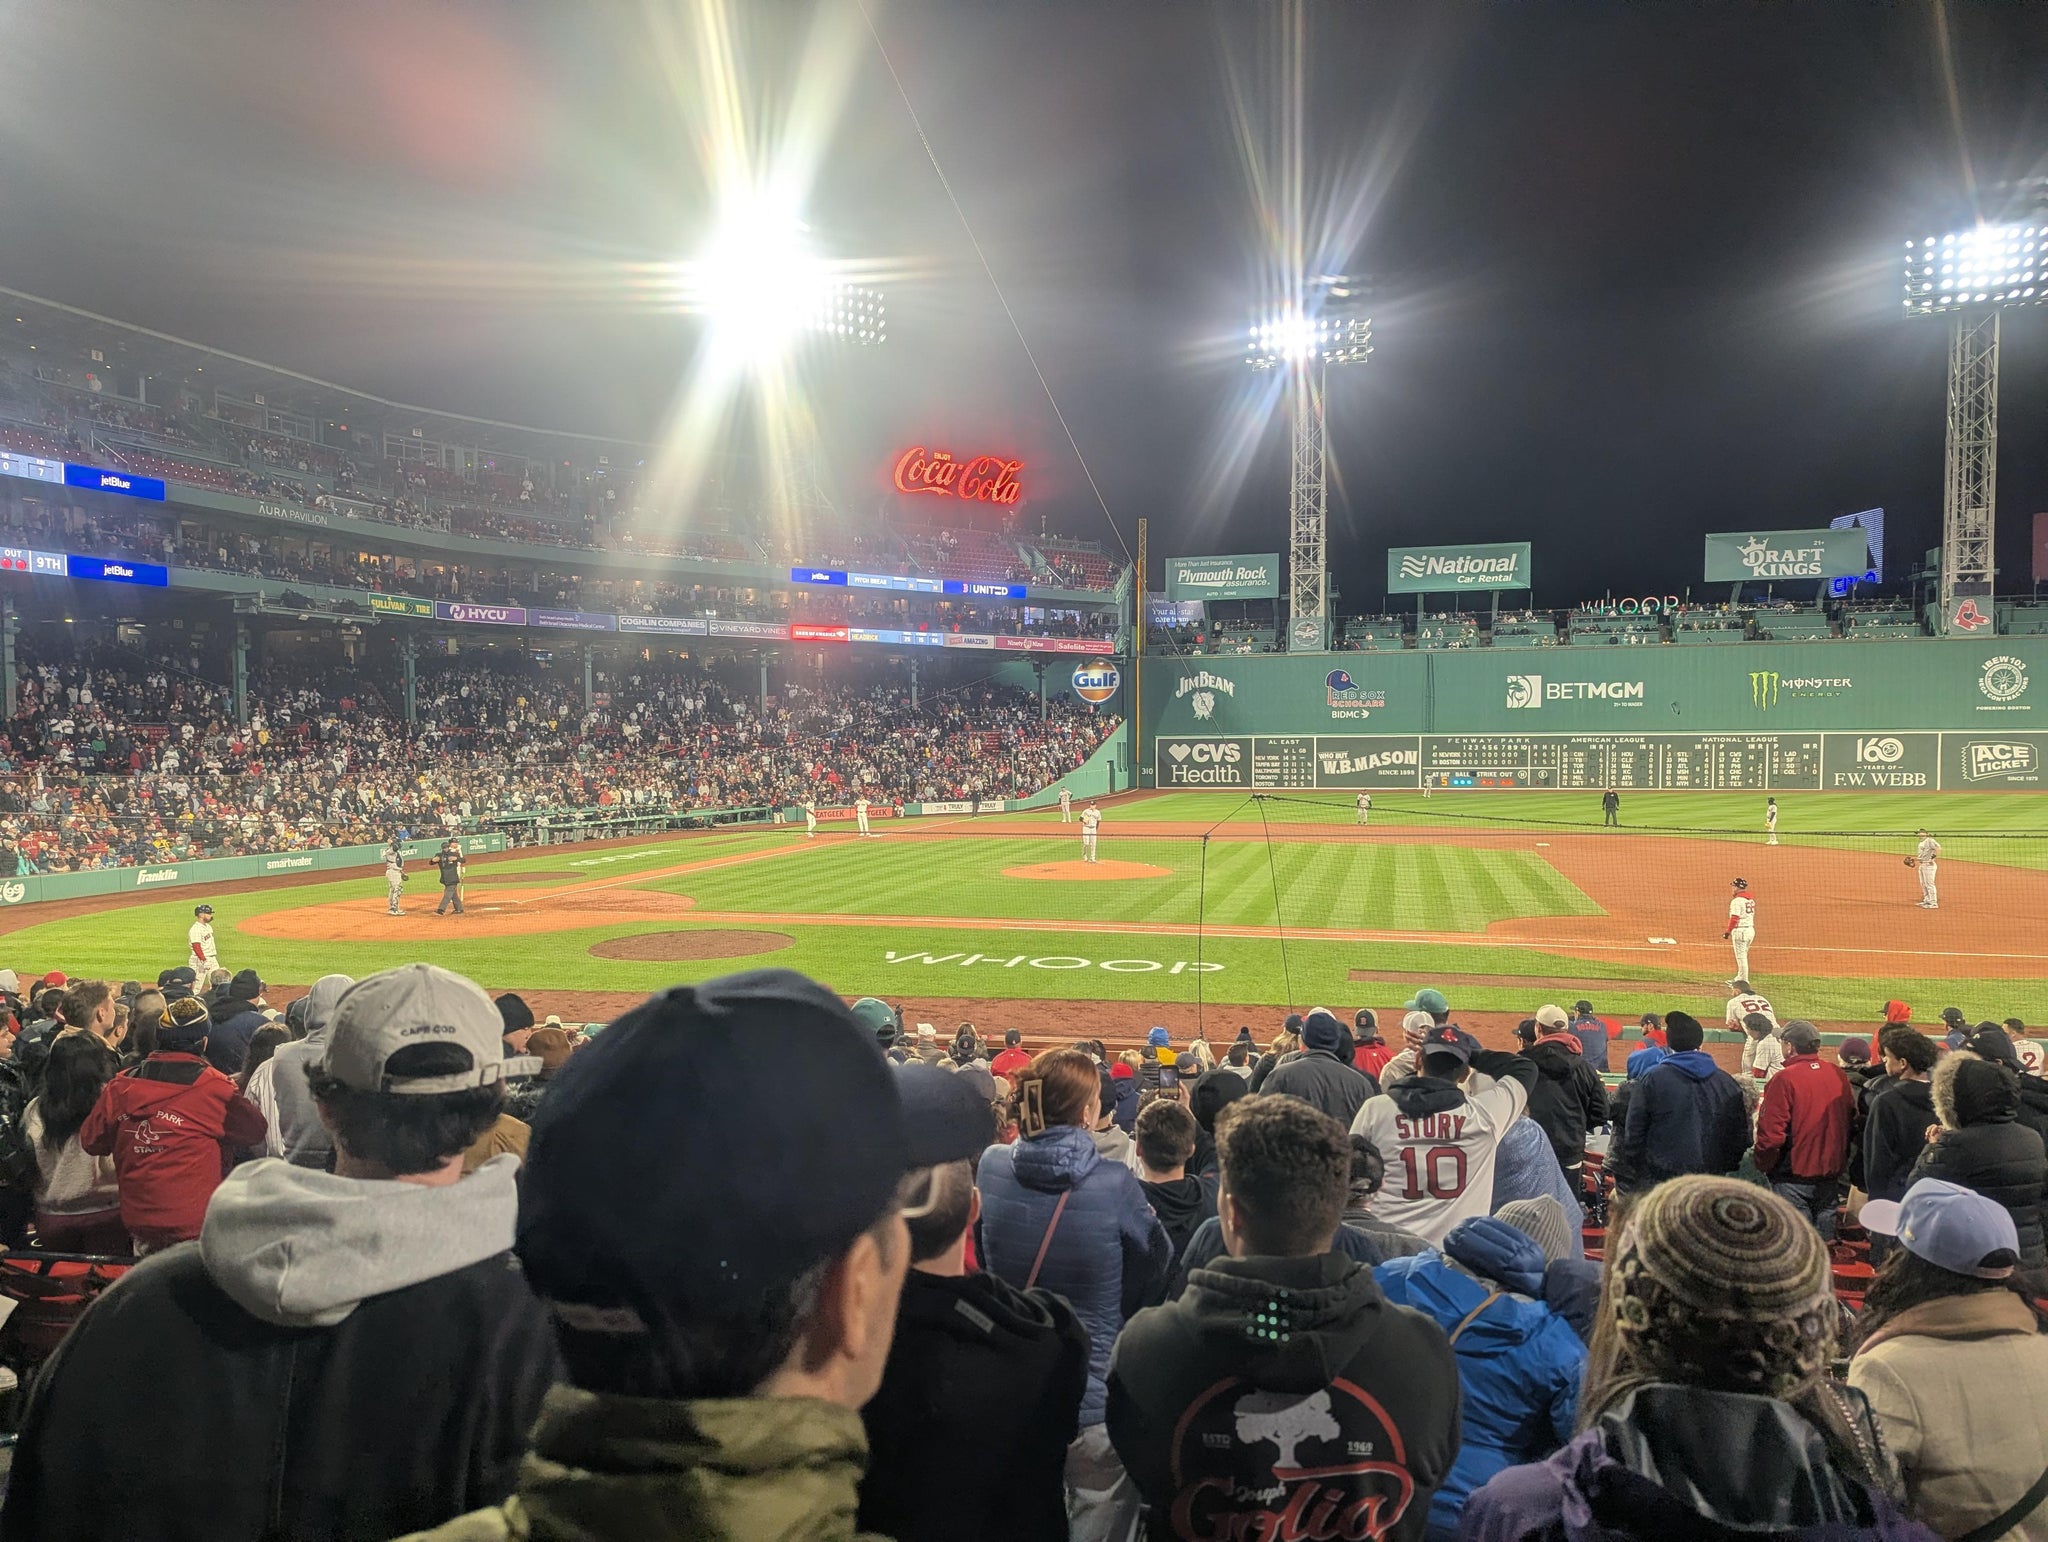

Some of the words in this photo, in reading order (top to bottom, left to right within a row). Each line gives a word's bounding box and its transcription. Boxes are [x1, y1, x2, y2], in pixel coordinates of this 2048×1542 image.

[934, 452, 951, 461] ENJOY
[3, 463, 9, 471] 0
[38, 468, 44, 476] 7
[101, 475, 131, 489] jetBlue
[289, 510, 328, 526] PAVILION
[5, 550, 22, 558] OUT
[1742, 548, 1825, 567] DRAFT
[36, 556, 61, 570] 9TH
[1426, 553, 1518, 575] National
[1753, 562, 1822, 577] KINGS
[104, 564, 133, 577] jetBlue
[1178, 567, 1234, 584] Plymouth
[1236, 566, 1267, 580] Rock
[1457, 575, 1475, 584] Car
[1478, 573, 1512, 583] Rental
[973, 585, 1008, 596] UNITED
[371, 600, 405, 612] SULLIVAN
[416, 604, 431, 615] TIRE
[1581, 595, 1679, 616] WHOOP
[468, 607, 507, 620] HYCU
[621, 617, 658, 627] COGHLIN
[658, 619, 706, 629] COMPANIES
[719, 624, 761, 634] VINEYARD
[763, 626, 787, 635] VINES
[1007, 640, 1024, 648] Ninety
[1058, 642, 1085, 651] Safelite
[1981, 656, 2009, 671] IBEW
[2009, 657, 2027, 671] 103
[1074, 672, 1117, 687] Gulf
[1199, 671, 1235, 698] BEAM
[1781, 677, 1852, 689] MONSTER
[1331, 690, 1357, 700] RED
[1360, 690, 1385, 700] SOX
[1546, 682, 1643, 700] BETMGM
[1978, 677, 1988, 695] NECA
[1986, 677, 2029, 702] CONTRACTORS
[1331, 700, 1385, 708] SCHOLARS
[1331, 710, 1360, 719] BIDMC
[1191, 743, 1241, 763] CVS
[1318, 752, 1334, 760] WHO
[1856, 737, 1904, 763] 160
[1976, 744, 2029, 762] ACE
[1141, 767, 1154, 775] 310
[1977, 759, 2029, 772] TICKET
[1170, 765, 1242, 783] Health
[1833, 772, 1866, 786] F.W.
[1870, 772, 1926, 786] WEBB
[266, 857, 313, 870] smartwater
[885, 951, 1225, 974] WHOOP
[1741, 1000, 1773, 1014] 52
[400, 1026, 430, 1037] CAPE
[432, 1025, 457, 1035] COD
[155, 1109, 185, 1127] PARK
[1395, 1113, 1467, 1140] STORY
[1399, 1146, 1468, 1200] 10
[1347, 1440, 1374, 1454] 1969
